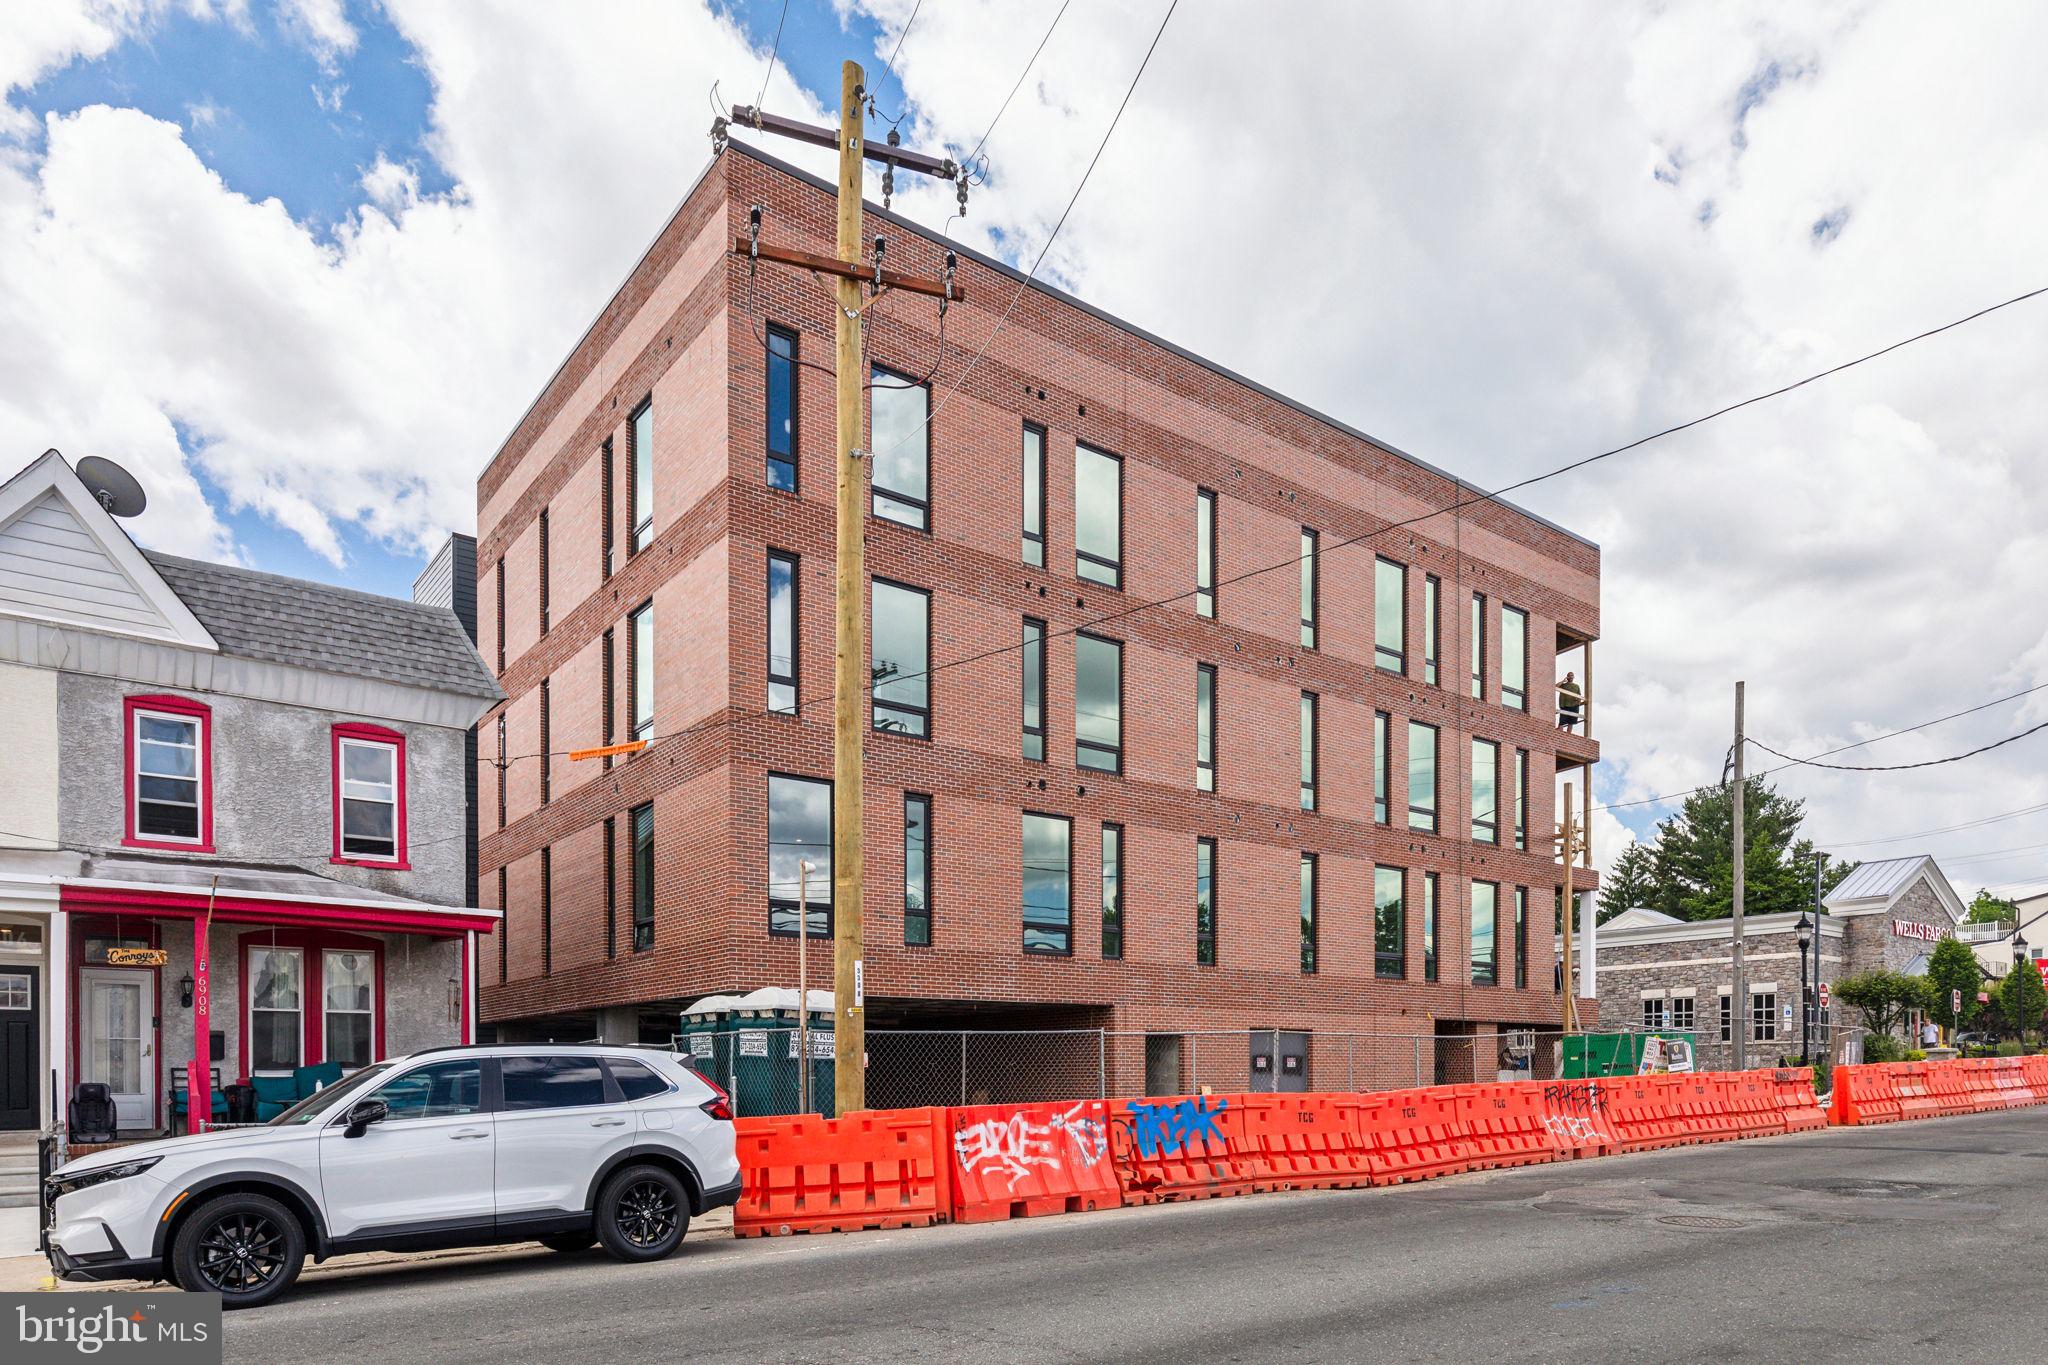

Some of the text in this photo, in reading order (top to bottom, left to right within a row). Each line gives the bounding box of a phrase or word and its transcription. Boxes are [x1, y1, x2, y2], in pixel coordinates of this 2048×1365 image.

[1894, 919, 1924, 940] WELLS
[110, 950, 155, 964] Conroys
[198, 977, 206, 1015] 6908
[1635, 1090, 1644, 1099] TCG
[1695, 1086, 1704, 1095] TCG
[1493, 1099, 1506, 1109] TCG
[1298, 1112, 1314, 1123] TCG
[1402, 1107, 1416, 1118] TCG
